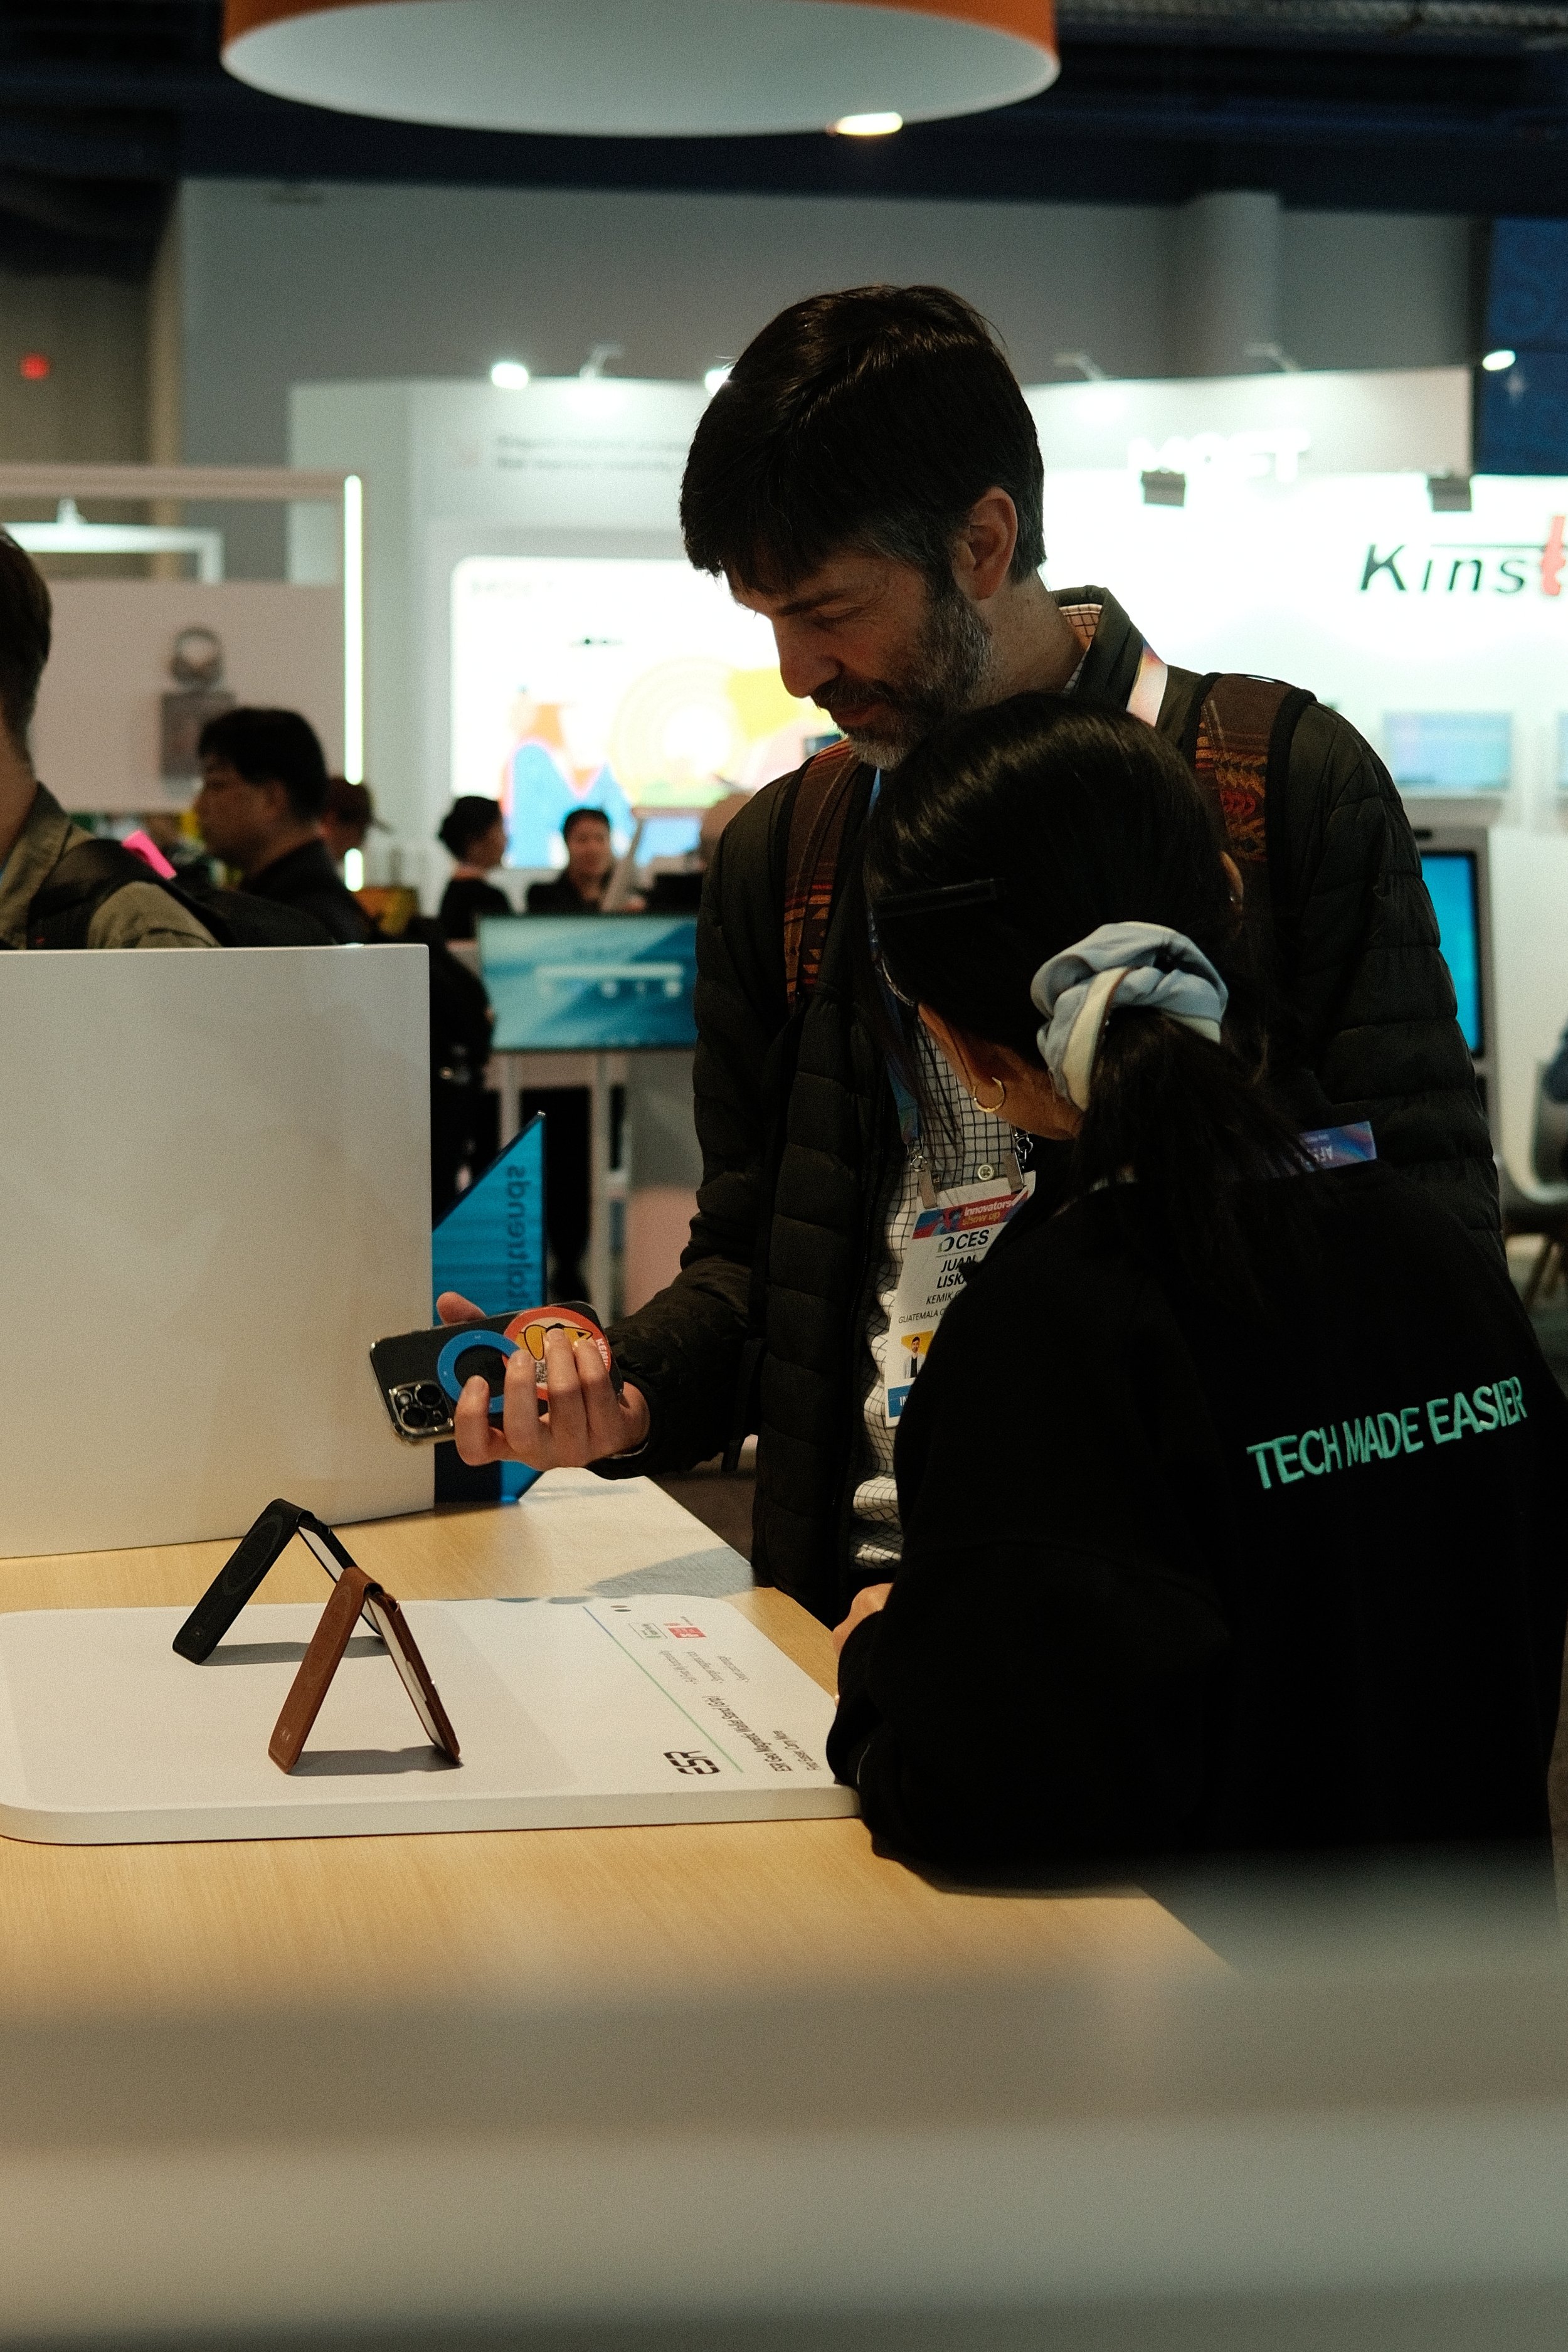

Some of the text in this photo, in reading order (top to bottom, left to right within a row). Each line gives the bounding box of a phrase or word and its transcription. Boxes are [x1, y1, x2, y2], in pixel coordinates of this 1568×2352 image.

[964, 1199, 1012, 1216] Innovators
[956, 1229, 990, 1249] CES
[926, 1291, 953, 1305] KEMIK
[898, 1310, 938, 1324] GUATEMALA
[1246, 1376, 1528, 1490] TECH MADE EASIER
[741, 1732, 771, 1753] Magnetic
[663, 1751, 721, 1775] ESR
